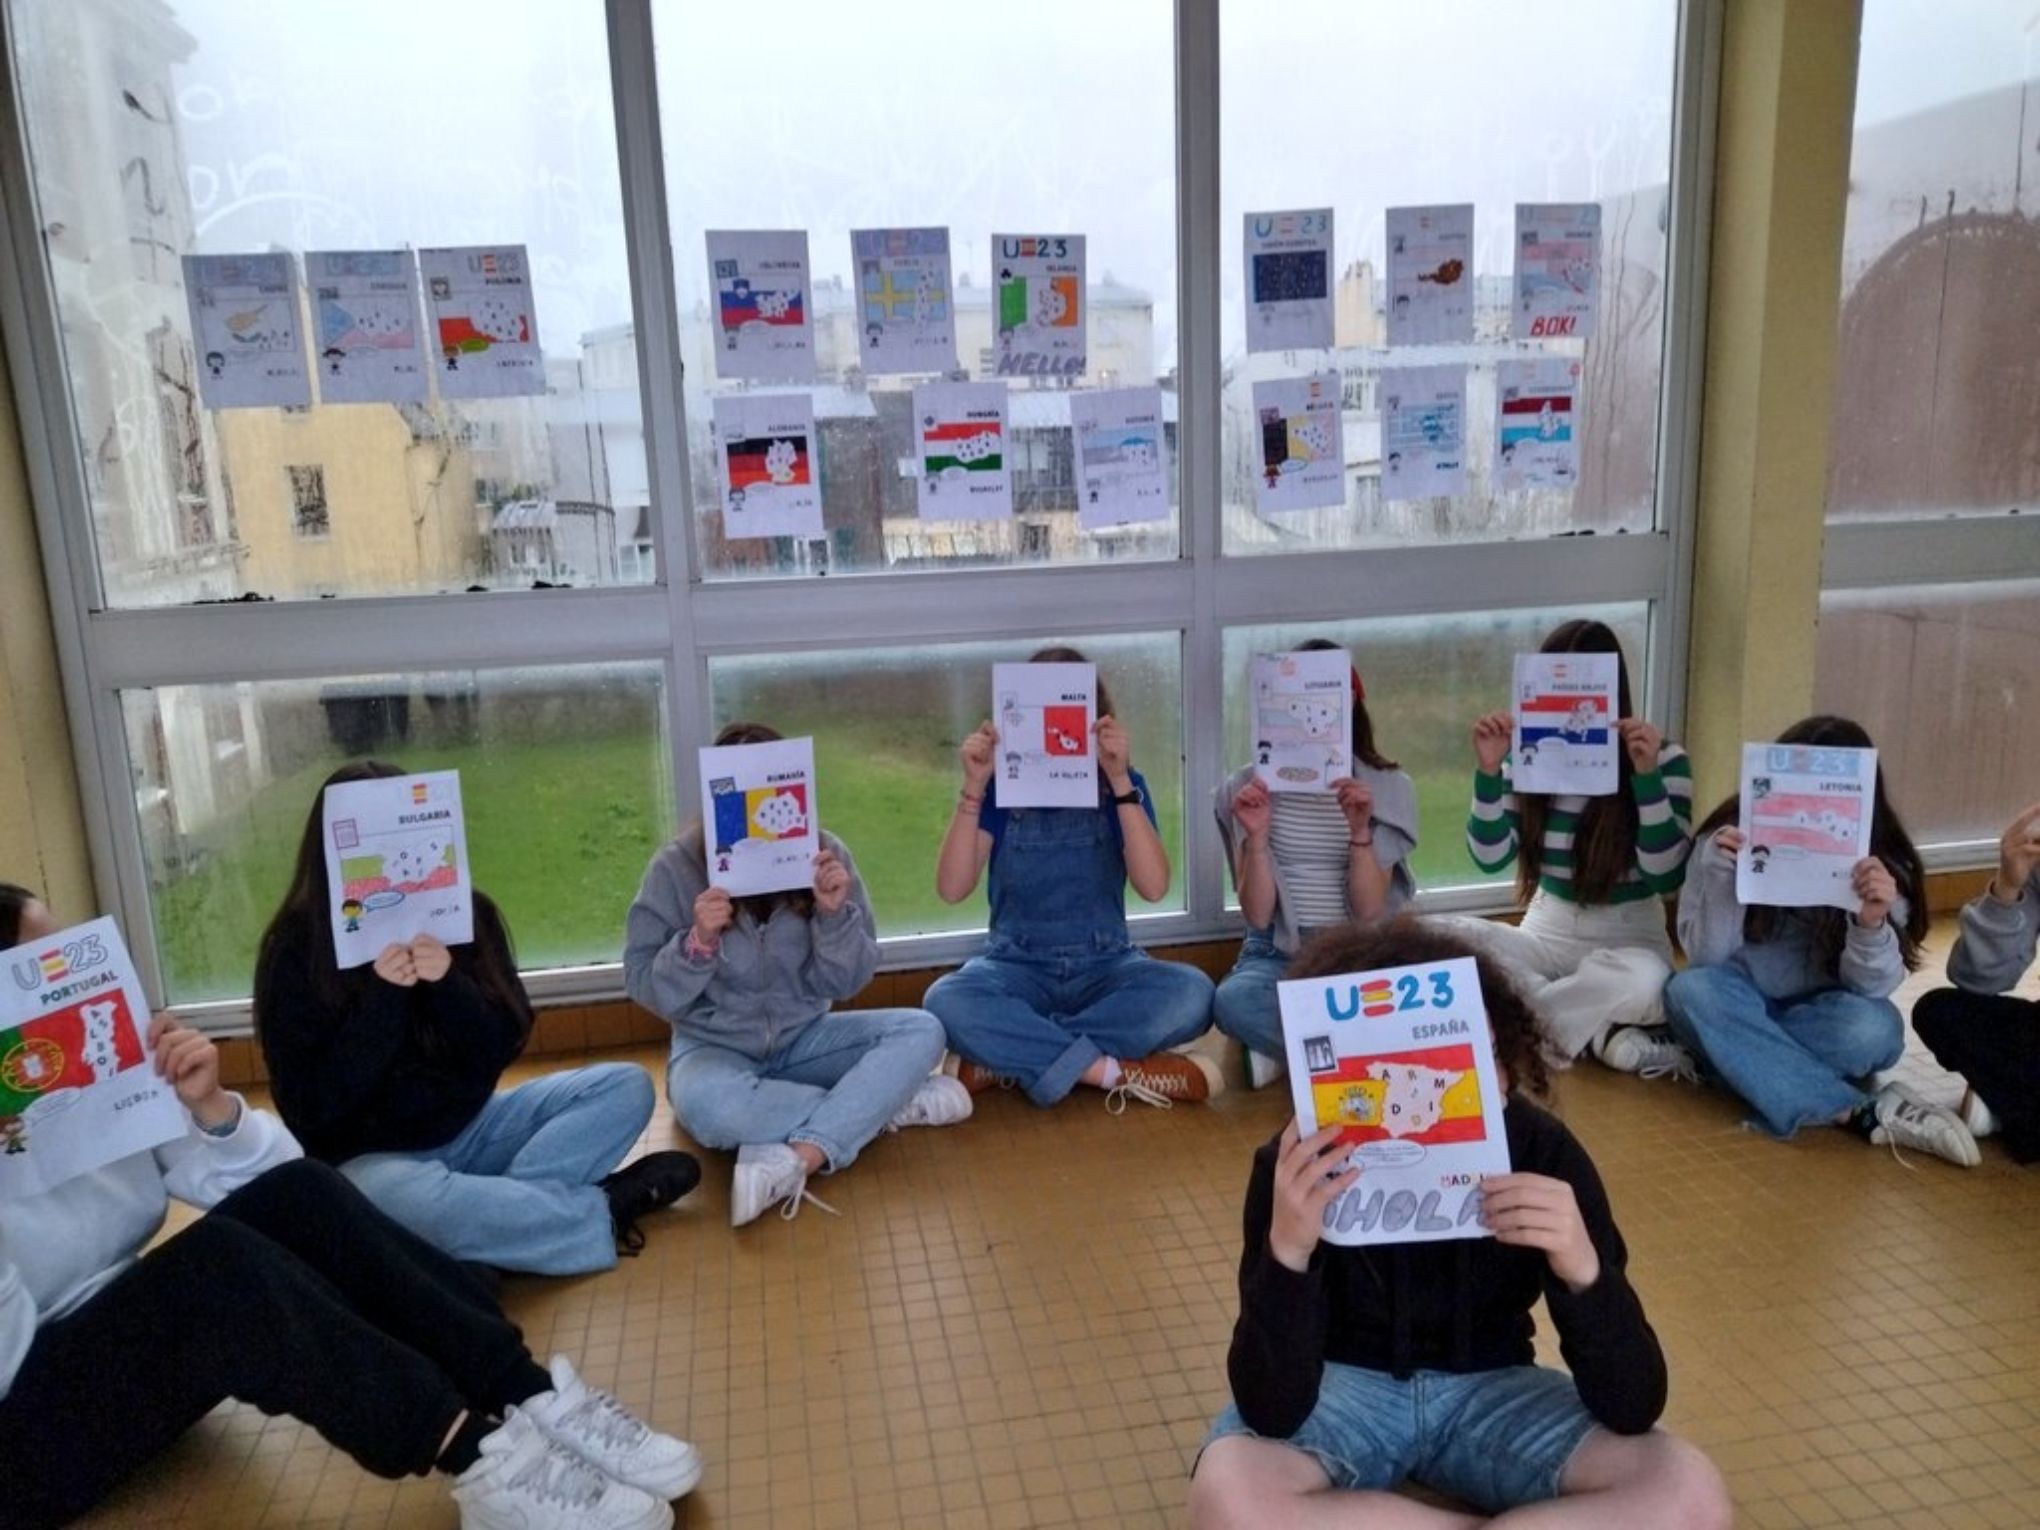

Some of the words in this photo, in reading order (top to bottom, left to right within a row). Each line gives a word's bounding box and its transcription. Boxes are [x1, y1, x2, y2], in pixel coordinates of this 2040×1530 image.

[1003, 238, 1068, 259] UE23
[998, 352, 1087, 376] HELLO!
[1061, 693, 1088, 702] MALTA
[1820, 782, 1863, 793] LETONIA
[398, 809, 452, 824] BULGARIA
[11, 934, 109, 991] UE23
[40, 970, 119, 1005] PORTUGAL
[1325, 971, 1455, 1021] UE23
[1412, 1020, 1470, 1040] ESPAÑA
